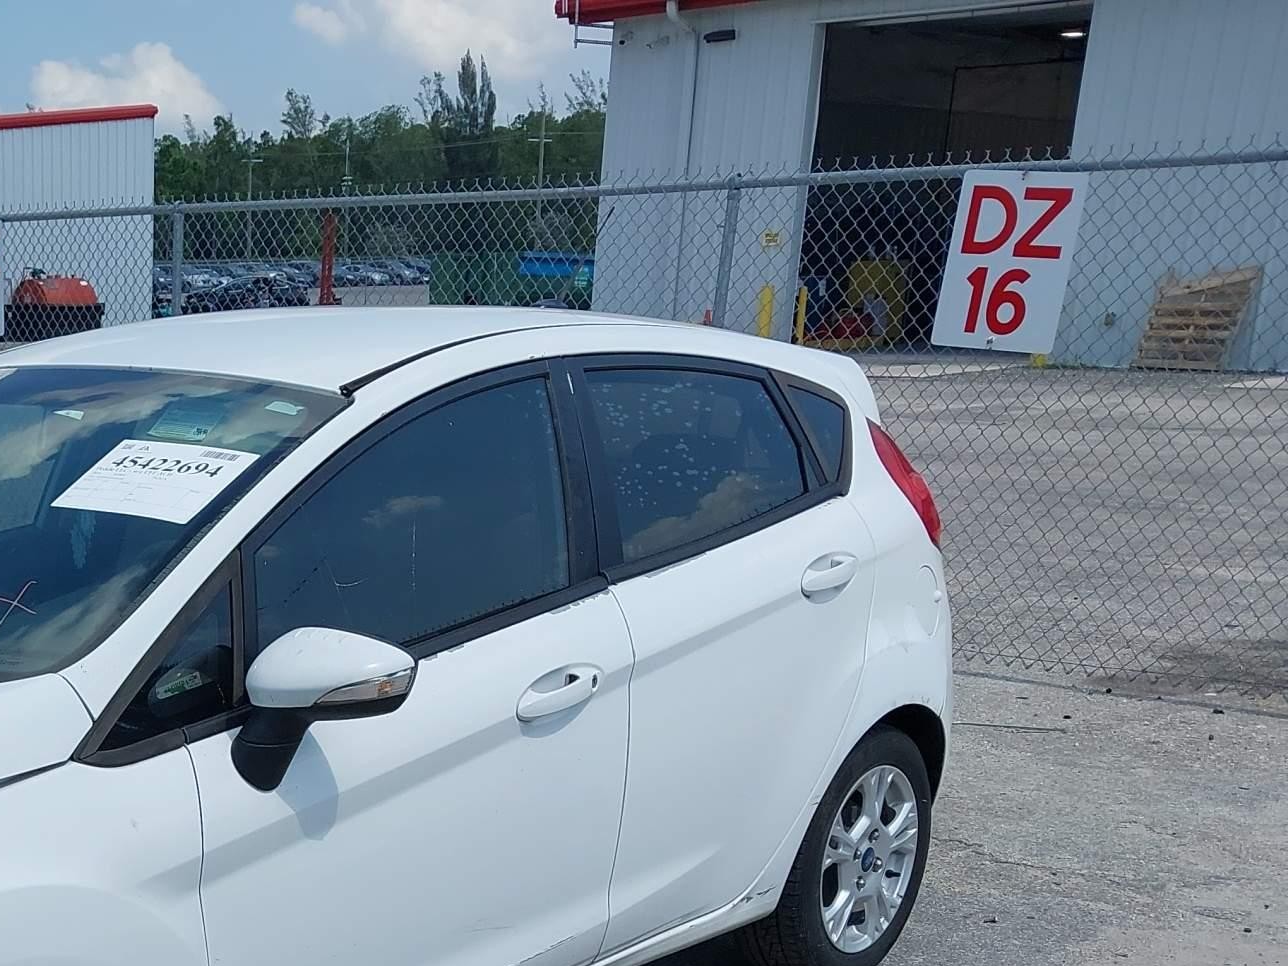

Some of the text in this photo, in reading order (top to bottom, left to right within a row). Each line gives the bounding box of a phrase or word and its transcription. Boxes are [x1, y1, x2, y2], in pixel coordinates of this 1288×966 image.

[961, 185, 1074, 260] DZ
[964, 267, 1031, 335] 16
[111, 455, 225, 478] 45422694
